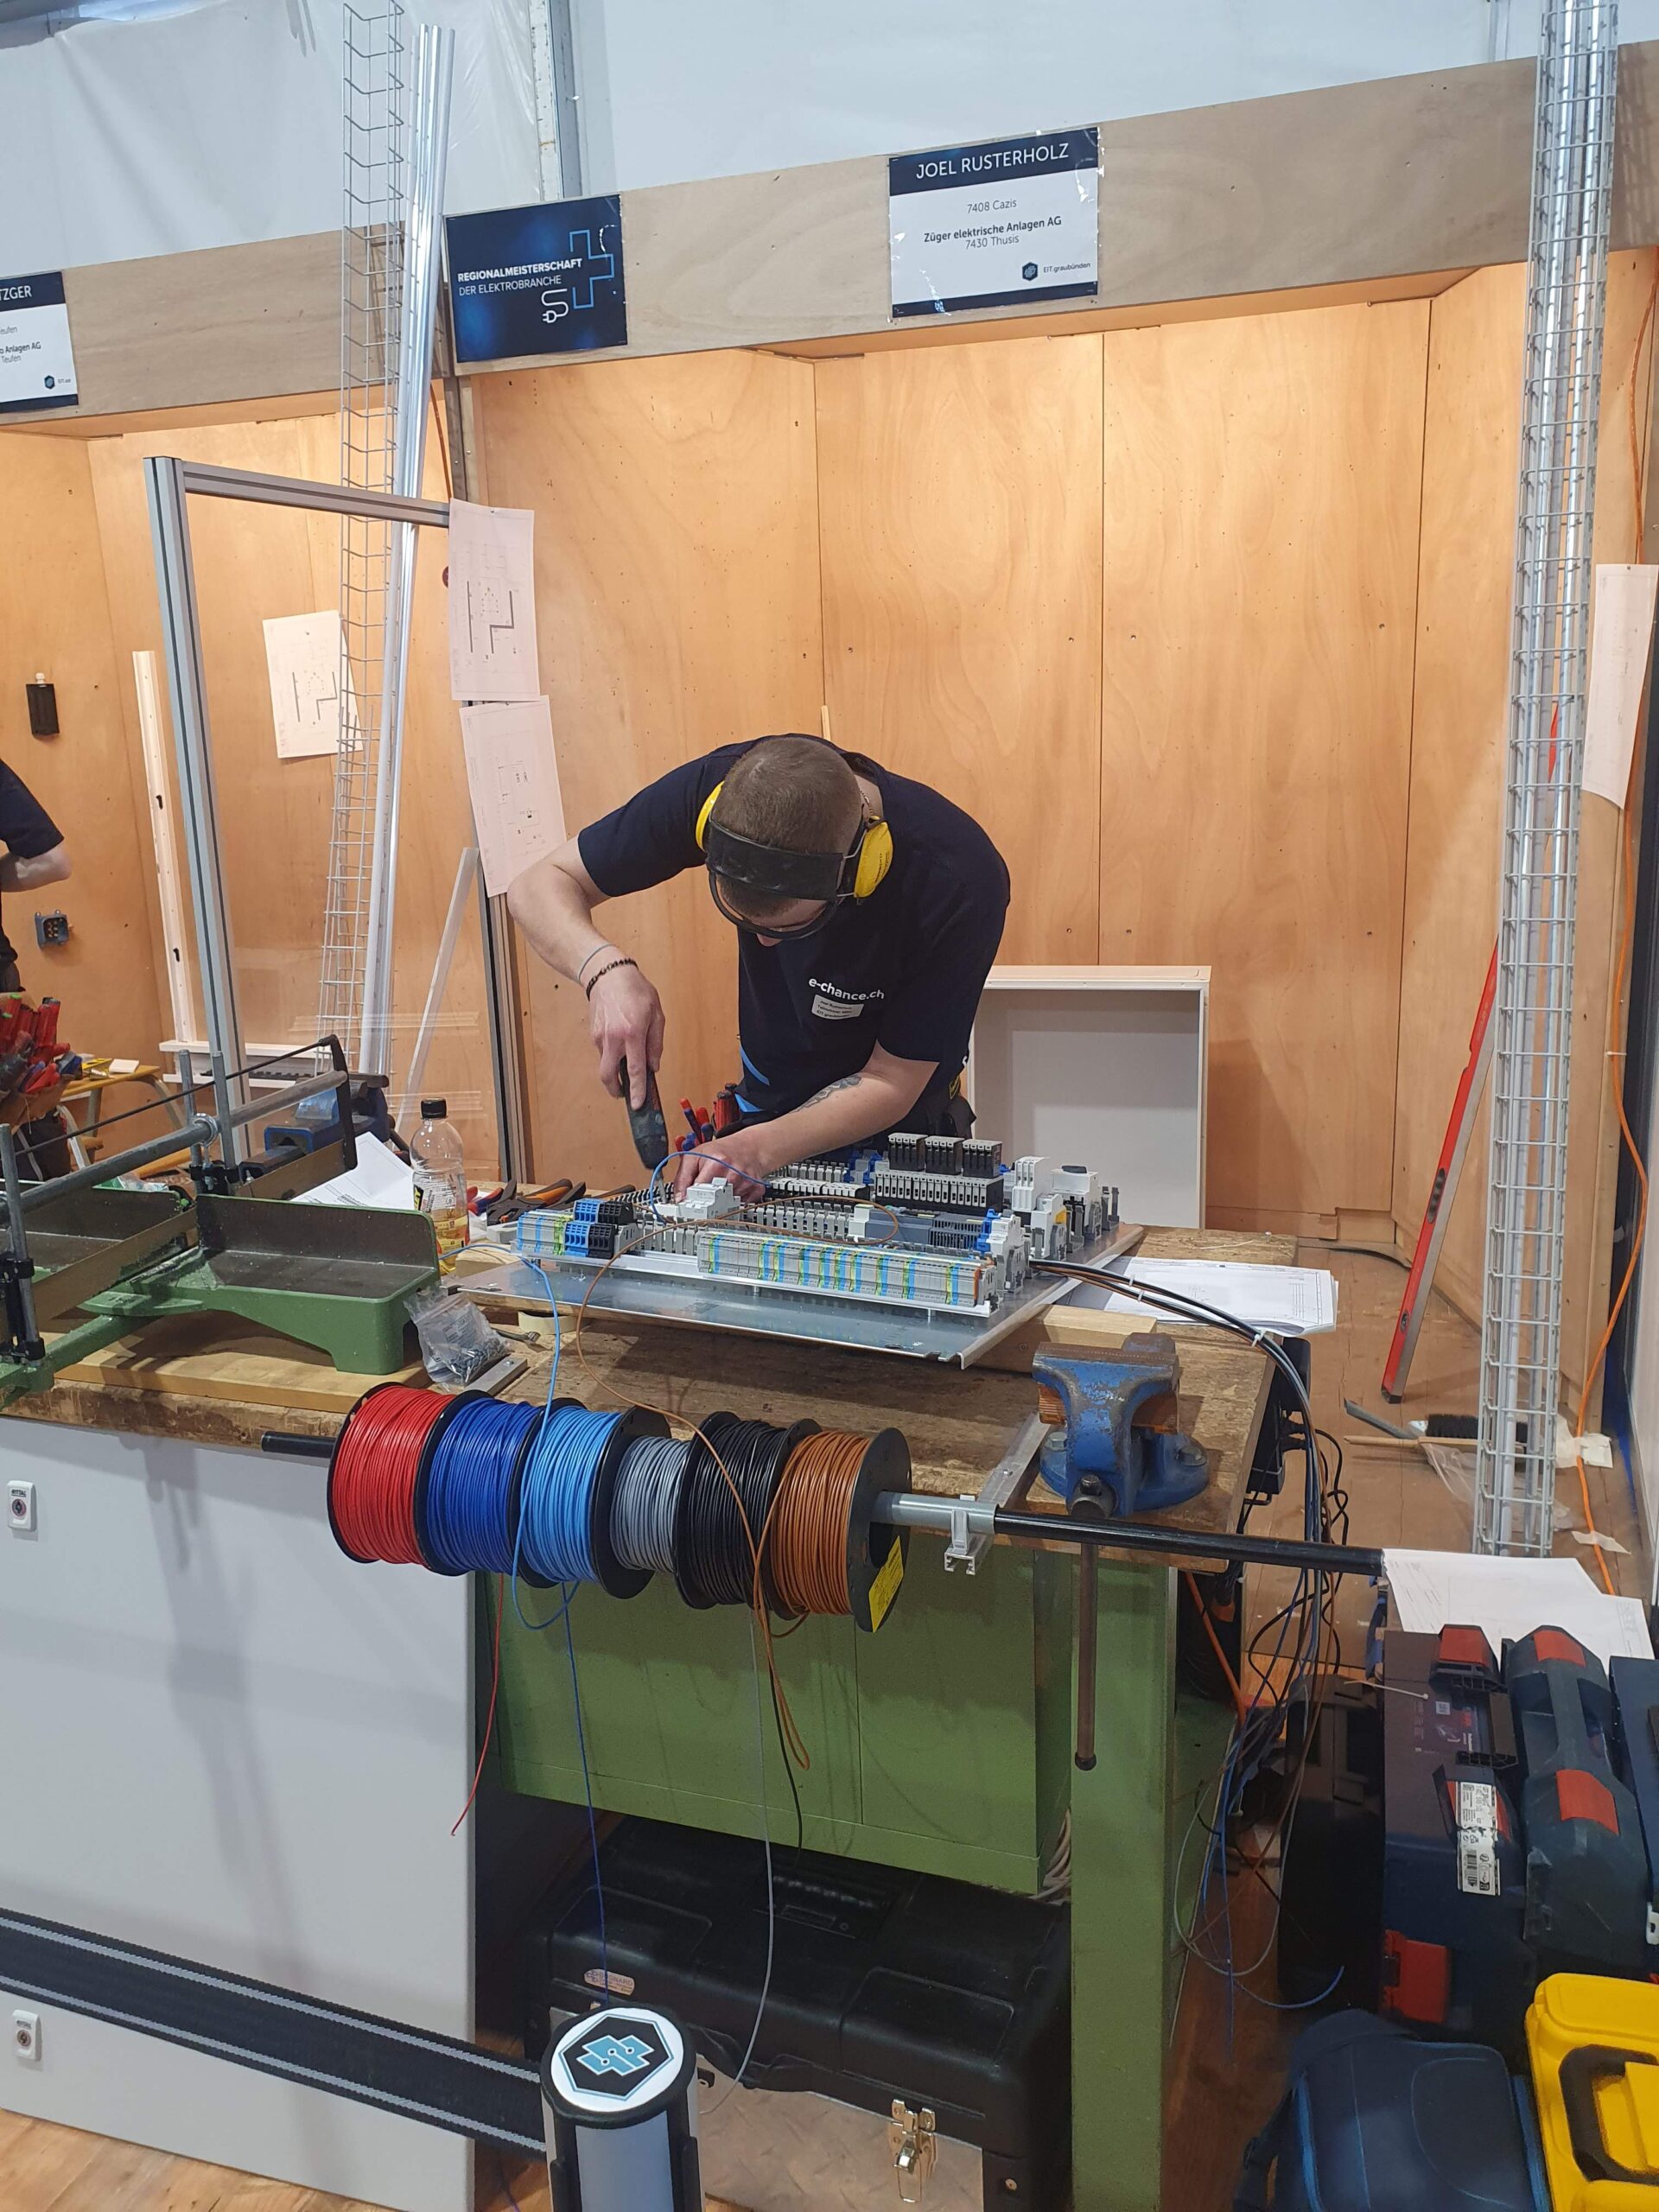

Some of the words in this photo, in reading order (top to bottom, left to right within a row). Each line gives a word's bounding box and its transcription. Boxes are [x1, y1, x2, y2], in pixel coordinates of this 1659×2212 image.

[916, 161, 957, 179] JOEL
[962, 143, 1069, 173] RUSTERHOLZ
[967, 201, 990, 213] 7408
[993, 198, 1017, 210] Cazis
[924, 232, 951, 243] Züger
[954, 225, 1004, 239] elektrische
[1006, 219, 1045, 232] Anlagen
[1047, 215, 1062, 226] AG
[965, 238, 988, 250] 7430
[991, 233, 1020, 246] Thusis
[458, 258, 583, 283] REGIONALMEISTERSCHAFT
[1043, 263, 1091, 273] EIT.graubünden
[459, 285, 476, 296] DER
[478, 274, 562, 294] ELEKTROBRANCHE
[5, 344, 30, 353] Anlagen
[31, 341, 41, 350] AG
[809, 978, 885, 1001] e-chance.ch
